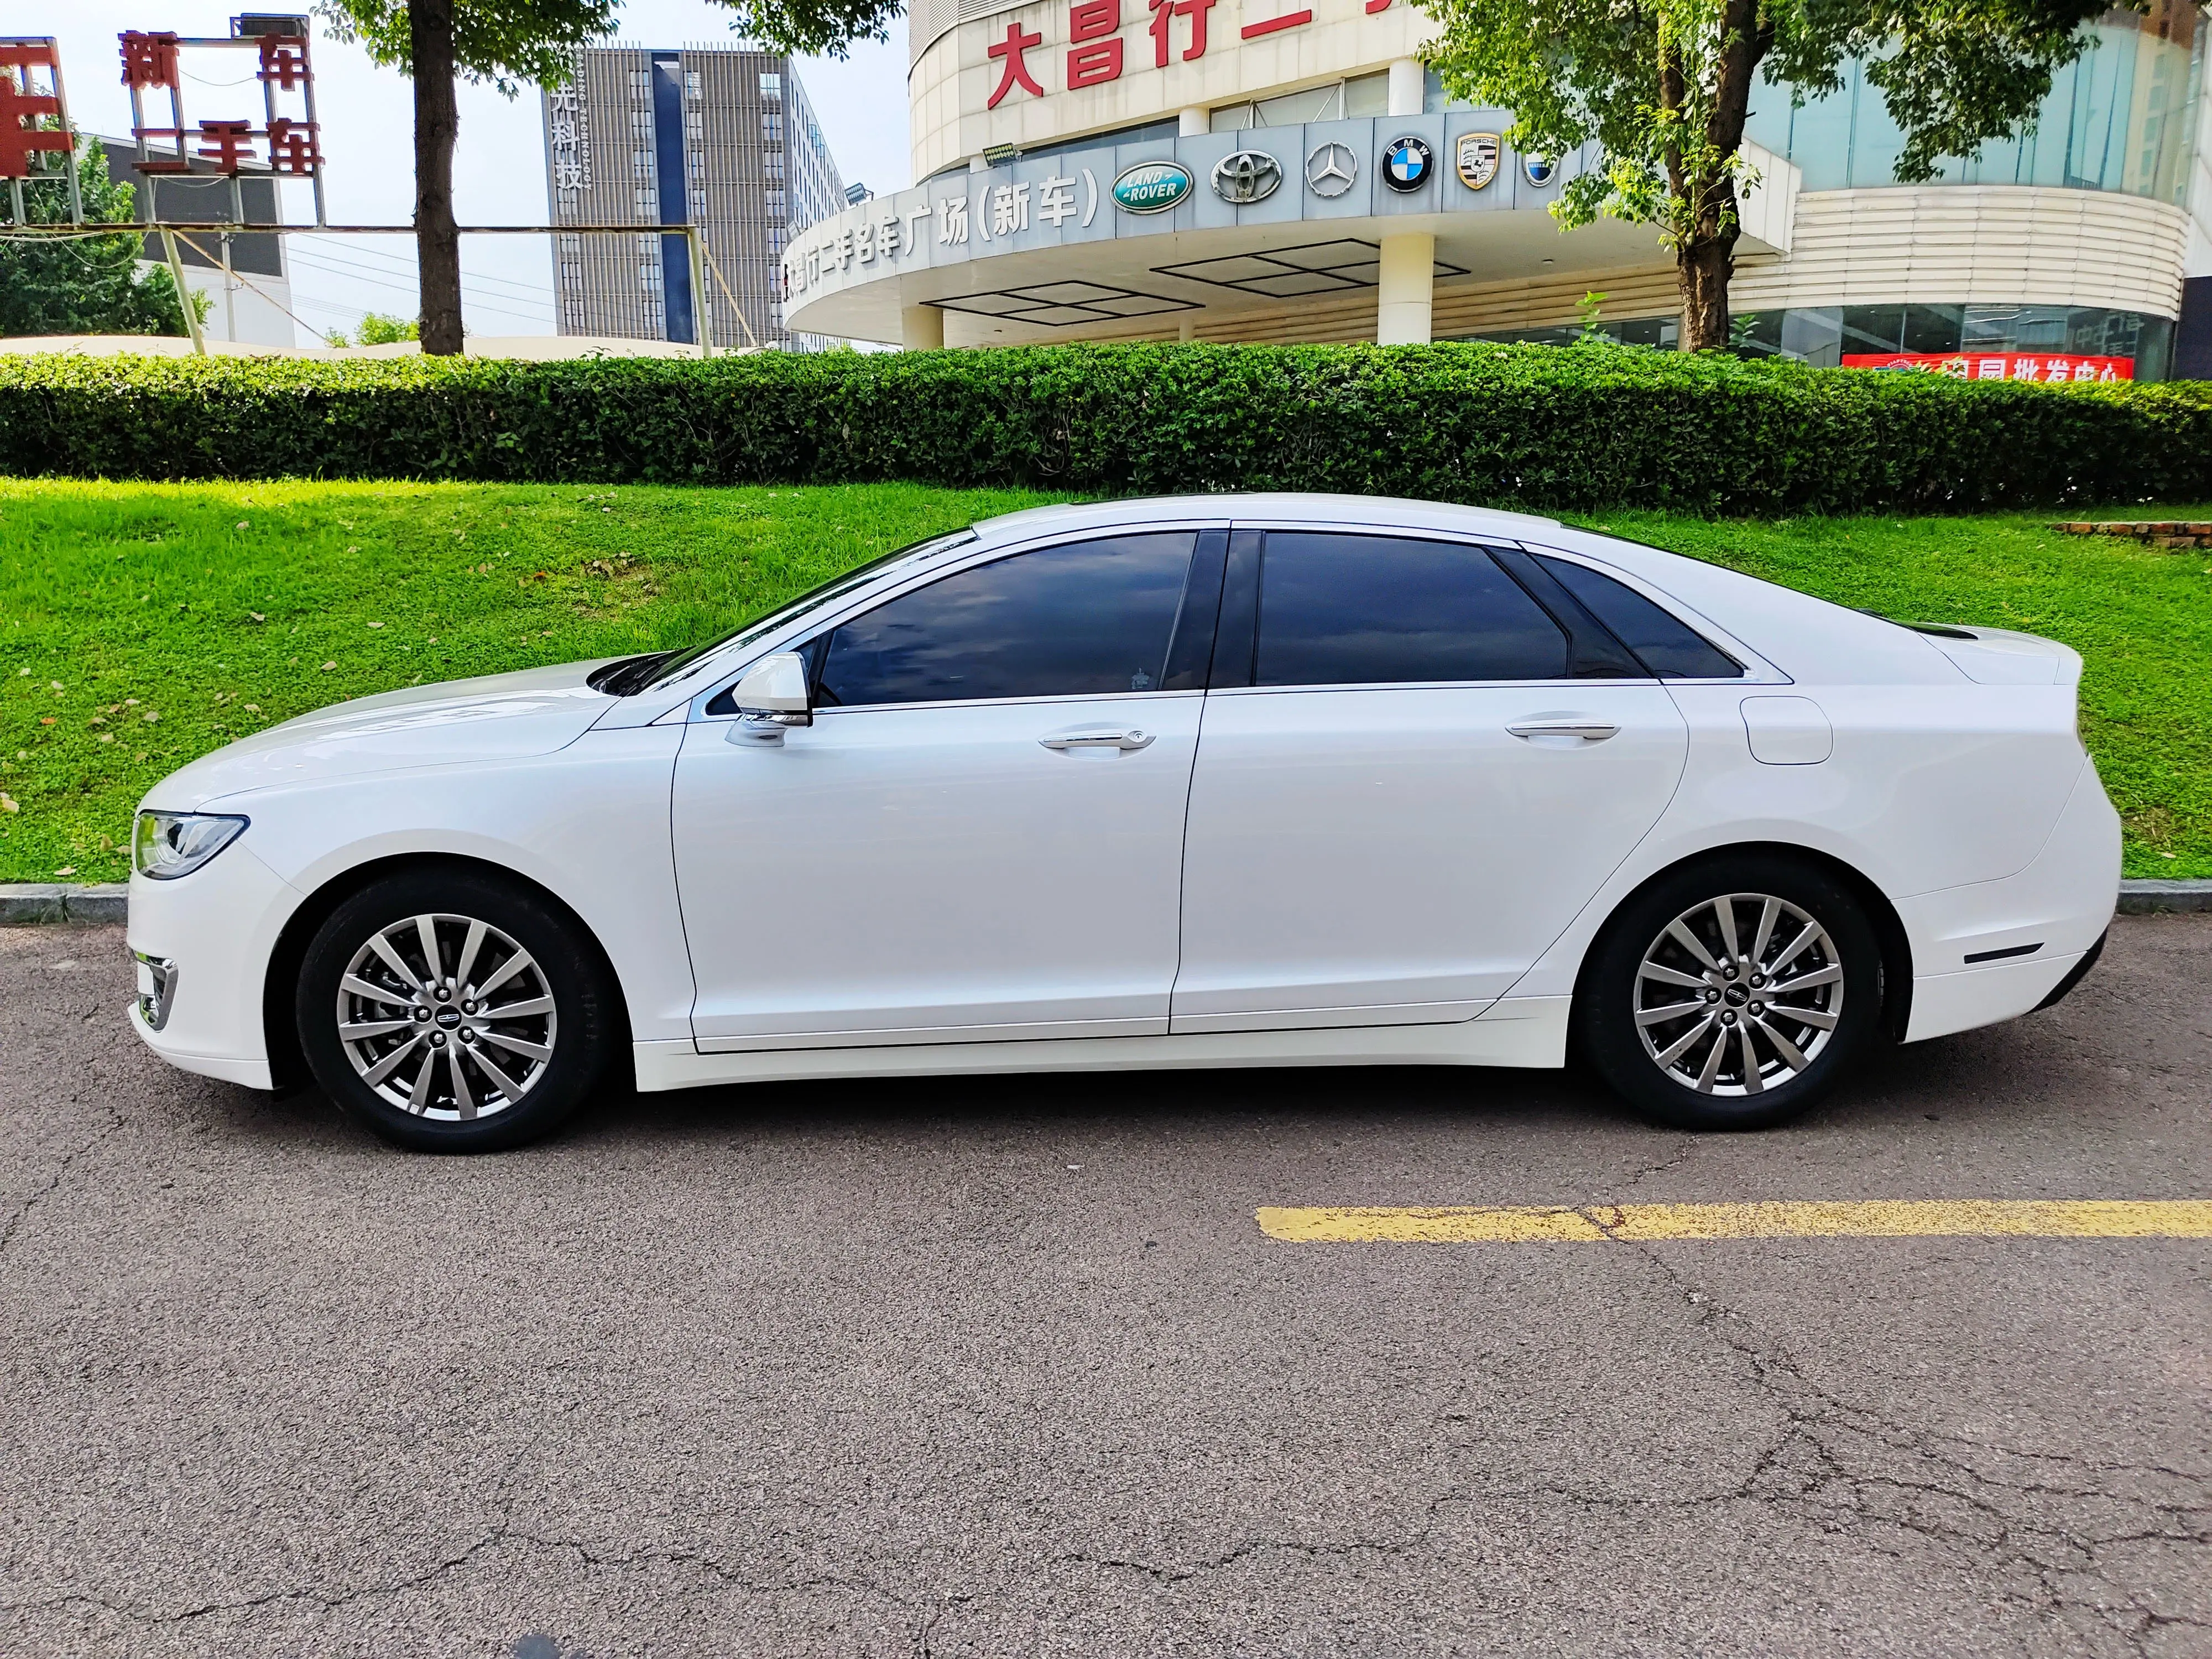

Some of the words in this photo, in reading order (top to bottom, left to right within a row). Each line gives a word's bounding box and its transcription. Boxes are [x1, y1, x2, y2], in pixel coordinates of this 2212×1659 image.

[550, 78, 584, 189] 先科技
[579, 108, 592, 190] TECHNOLOGY
[1387, 139, 1430, 156] BMW
[1126, 171, 1163, 189] LAND
[1130, 182, 1177, 202] ROVER
